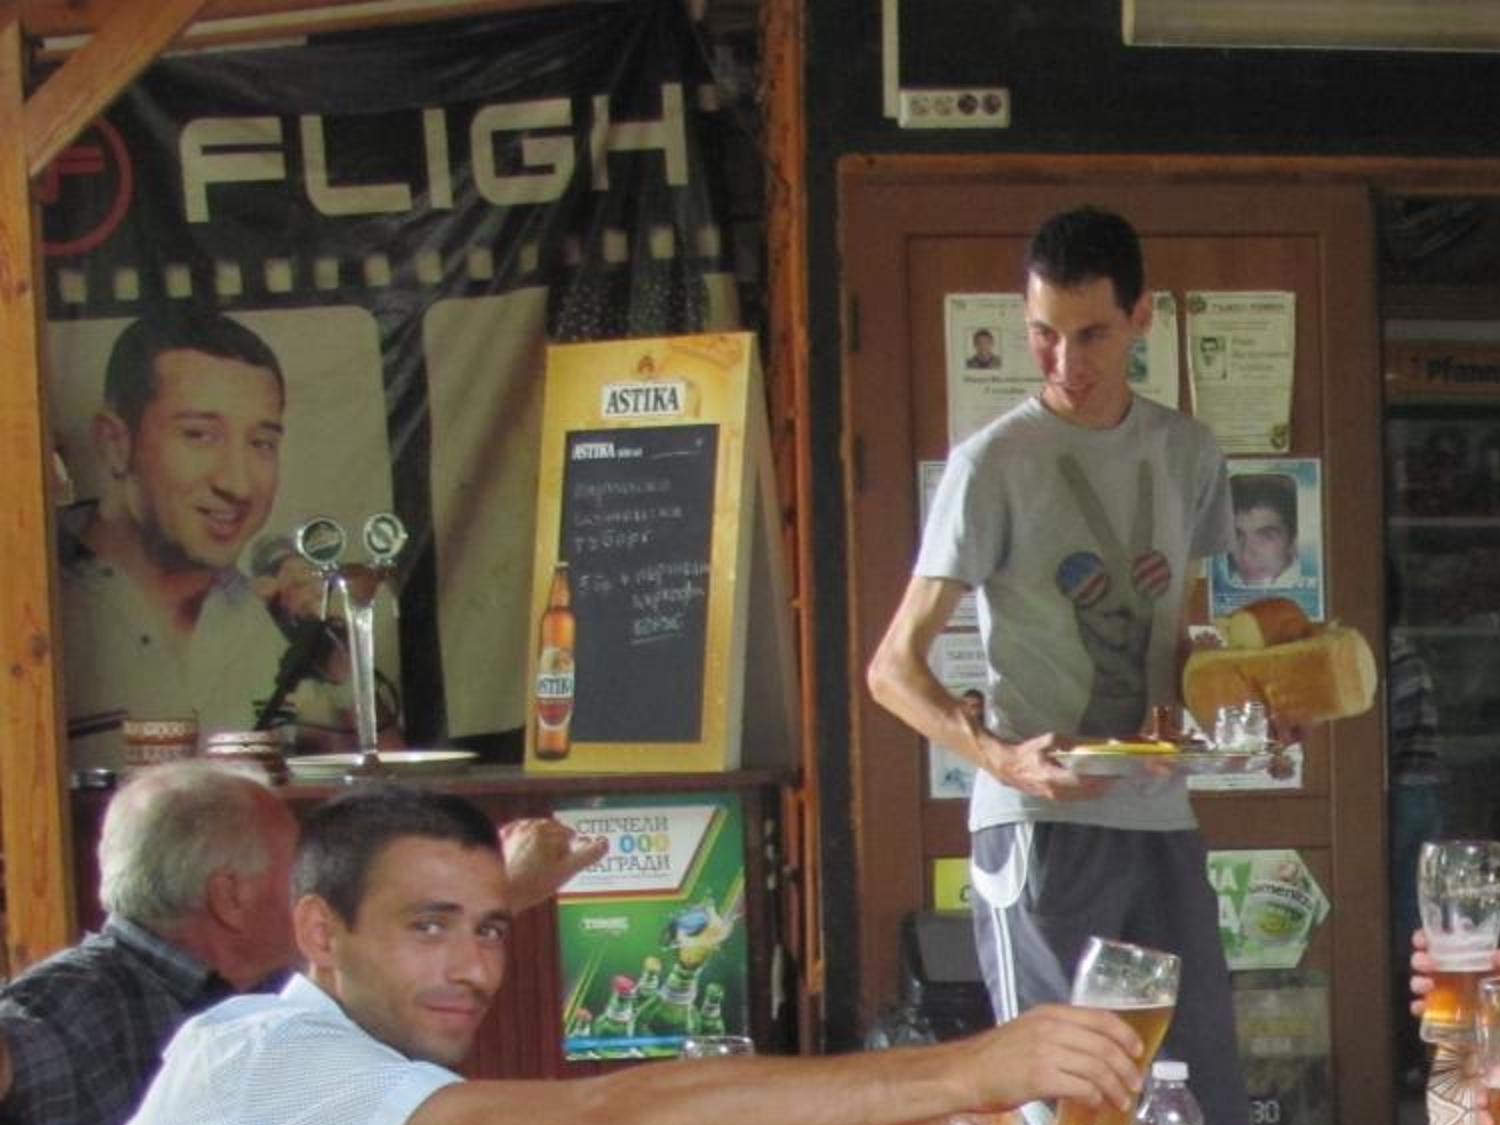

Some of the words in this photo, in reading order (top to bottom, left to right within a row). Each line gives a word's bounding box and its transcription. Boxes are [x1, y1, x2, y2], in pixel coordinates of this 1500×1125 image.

[179, 82, 718, 223] FLIGH
[604, 386, 681, 414] ASTIKA
[571, 441, 615, 461] ASTIKA
